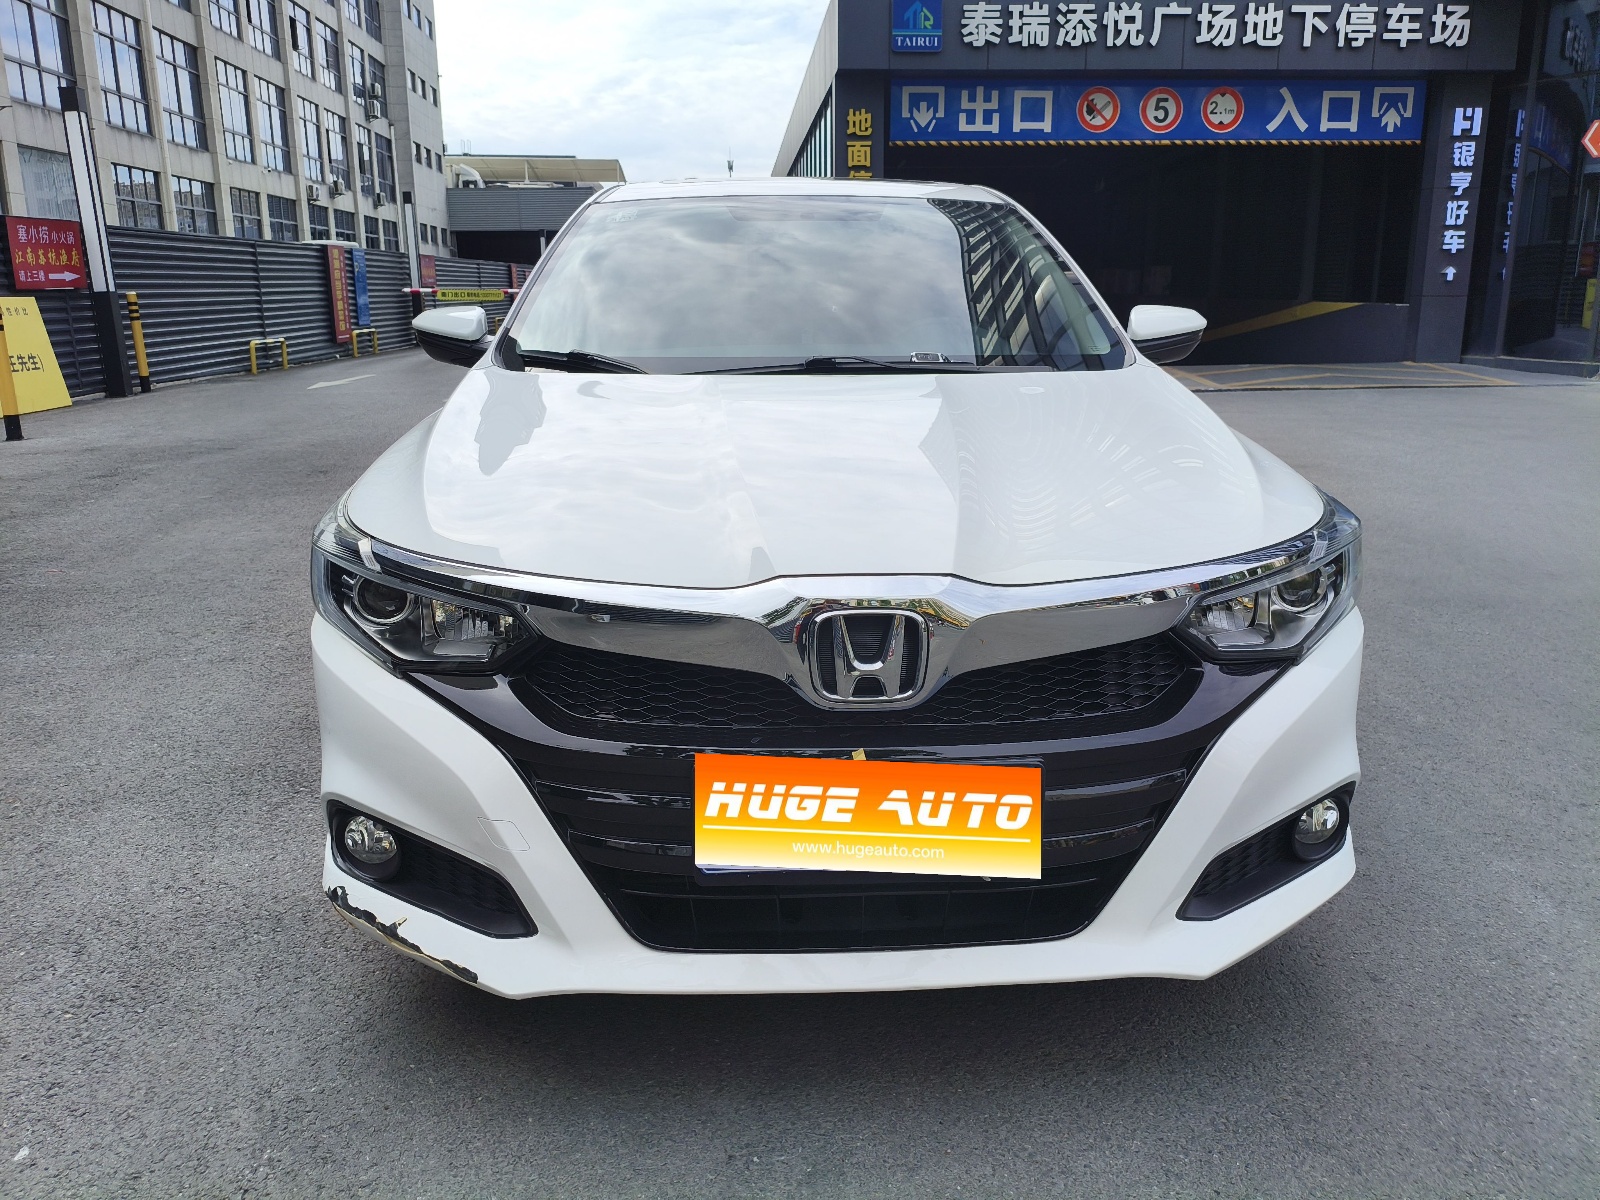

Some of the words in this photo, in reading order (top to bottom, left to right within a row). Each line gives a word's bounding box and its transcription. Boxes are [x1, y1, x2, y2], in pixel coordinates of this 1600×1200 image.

[960, 1, 1472, 48] 泰瑞添悦广场地下停车场
[895, 36, 939, 47] TAIRUI
[958, 85, 1054, 134] 出口
[1153, 97, 1170, 124] 5
[1209, 101, 1236, 116] 2.1m
[1265, 86, 1361, 133] 入口
[16, 224, 49, 244] 塞小捞
[51, 230, 75, 245] 小火锅
[18, 269, 46, 282] 请上三楼
[1, 305, 29, 317] 性价比
